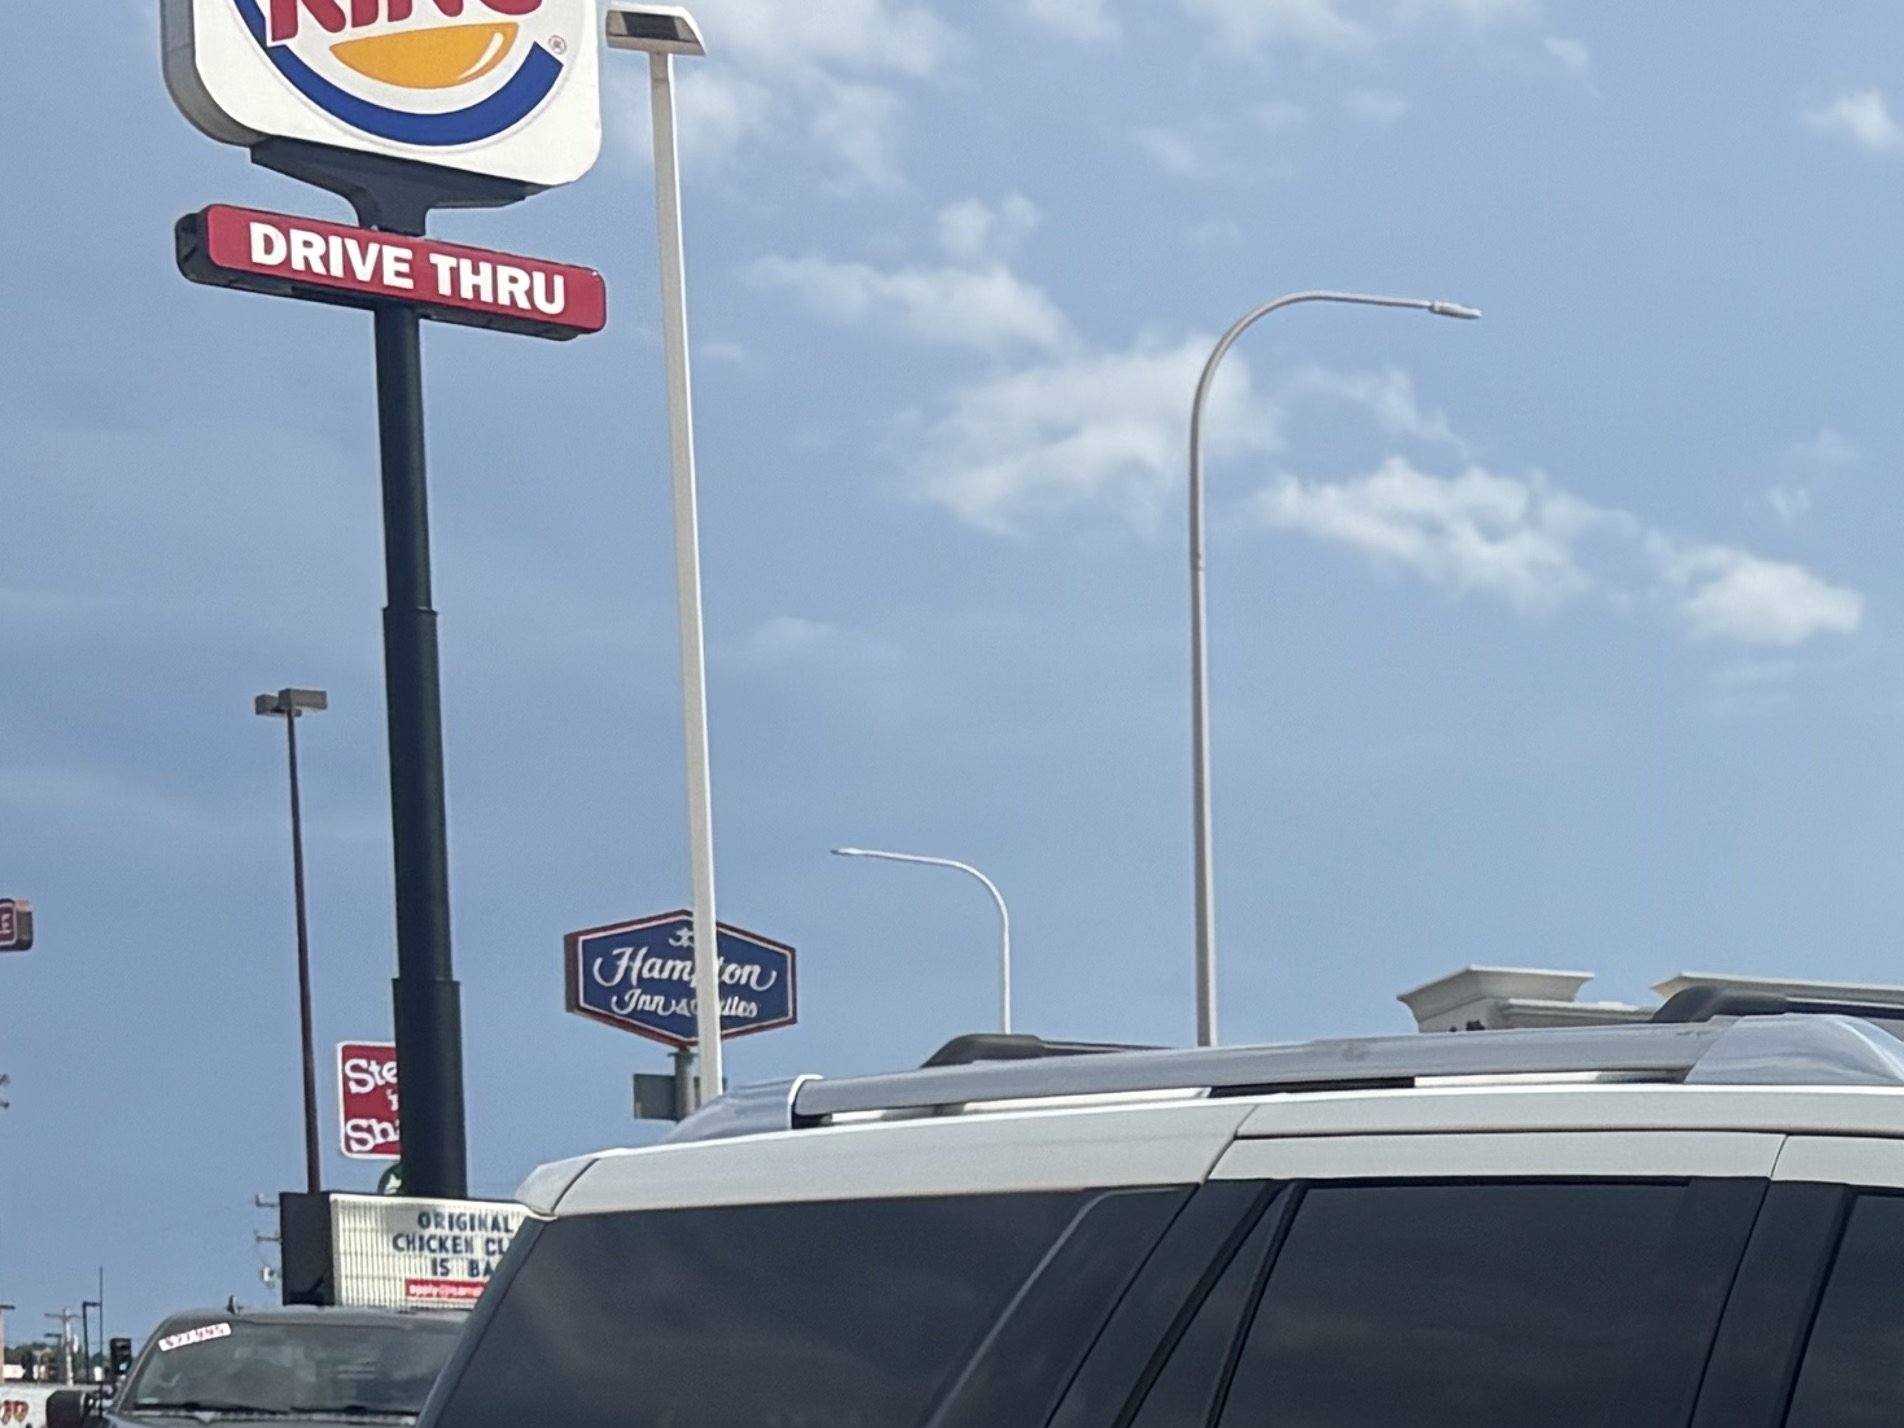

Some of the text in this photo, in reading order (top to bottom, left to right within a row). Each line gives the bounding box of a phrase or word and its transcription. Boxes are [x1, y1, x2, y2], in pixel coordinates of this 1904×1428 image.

[249, 221, 566, 315] DRIVE THRU
[592, 946, 778, 992] Hamon
[611, 988, 676, 1016] Inn
[417, 1210, 514, 1233] ORIGINAL
[392, 1232, 475, 1255] CHICKEN
[431, 1257, 450, 1277] IS
